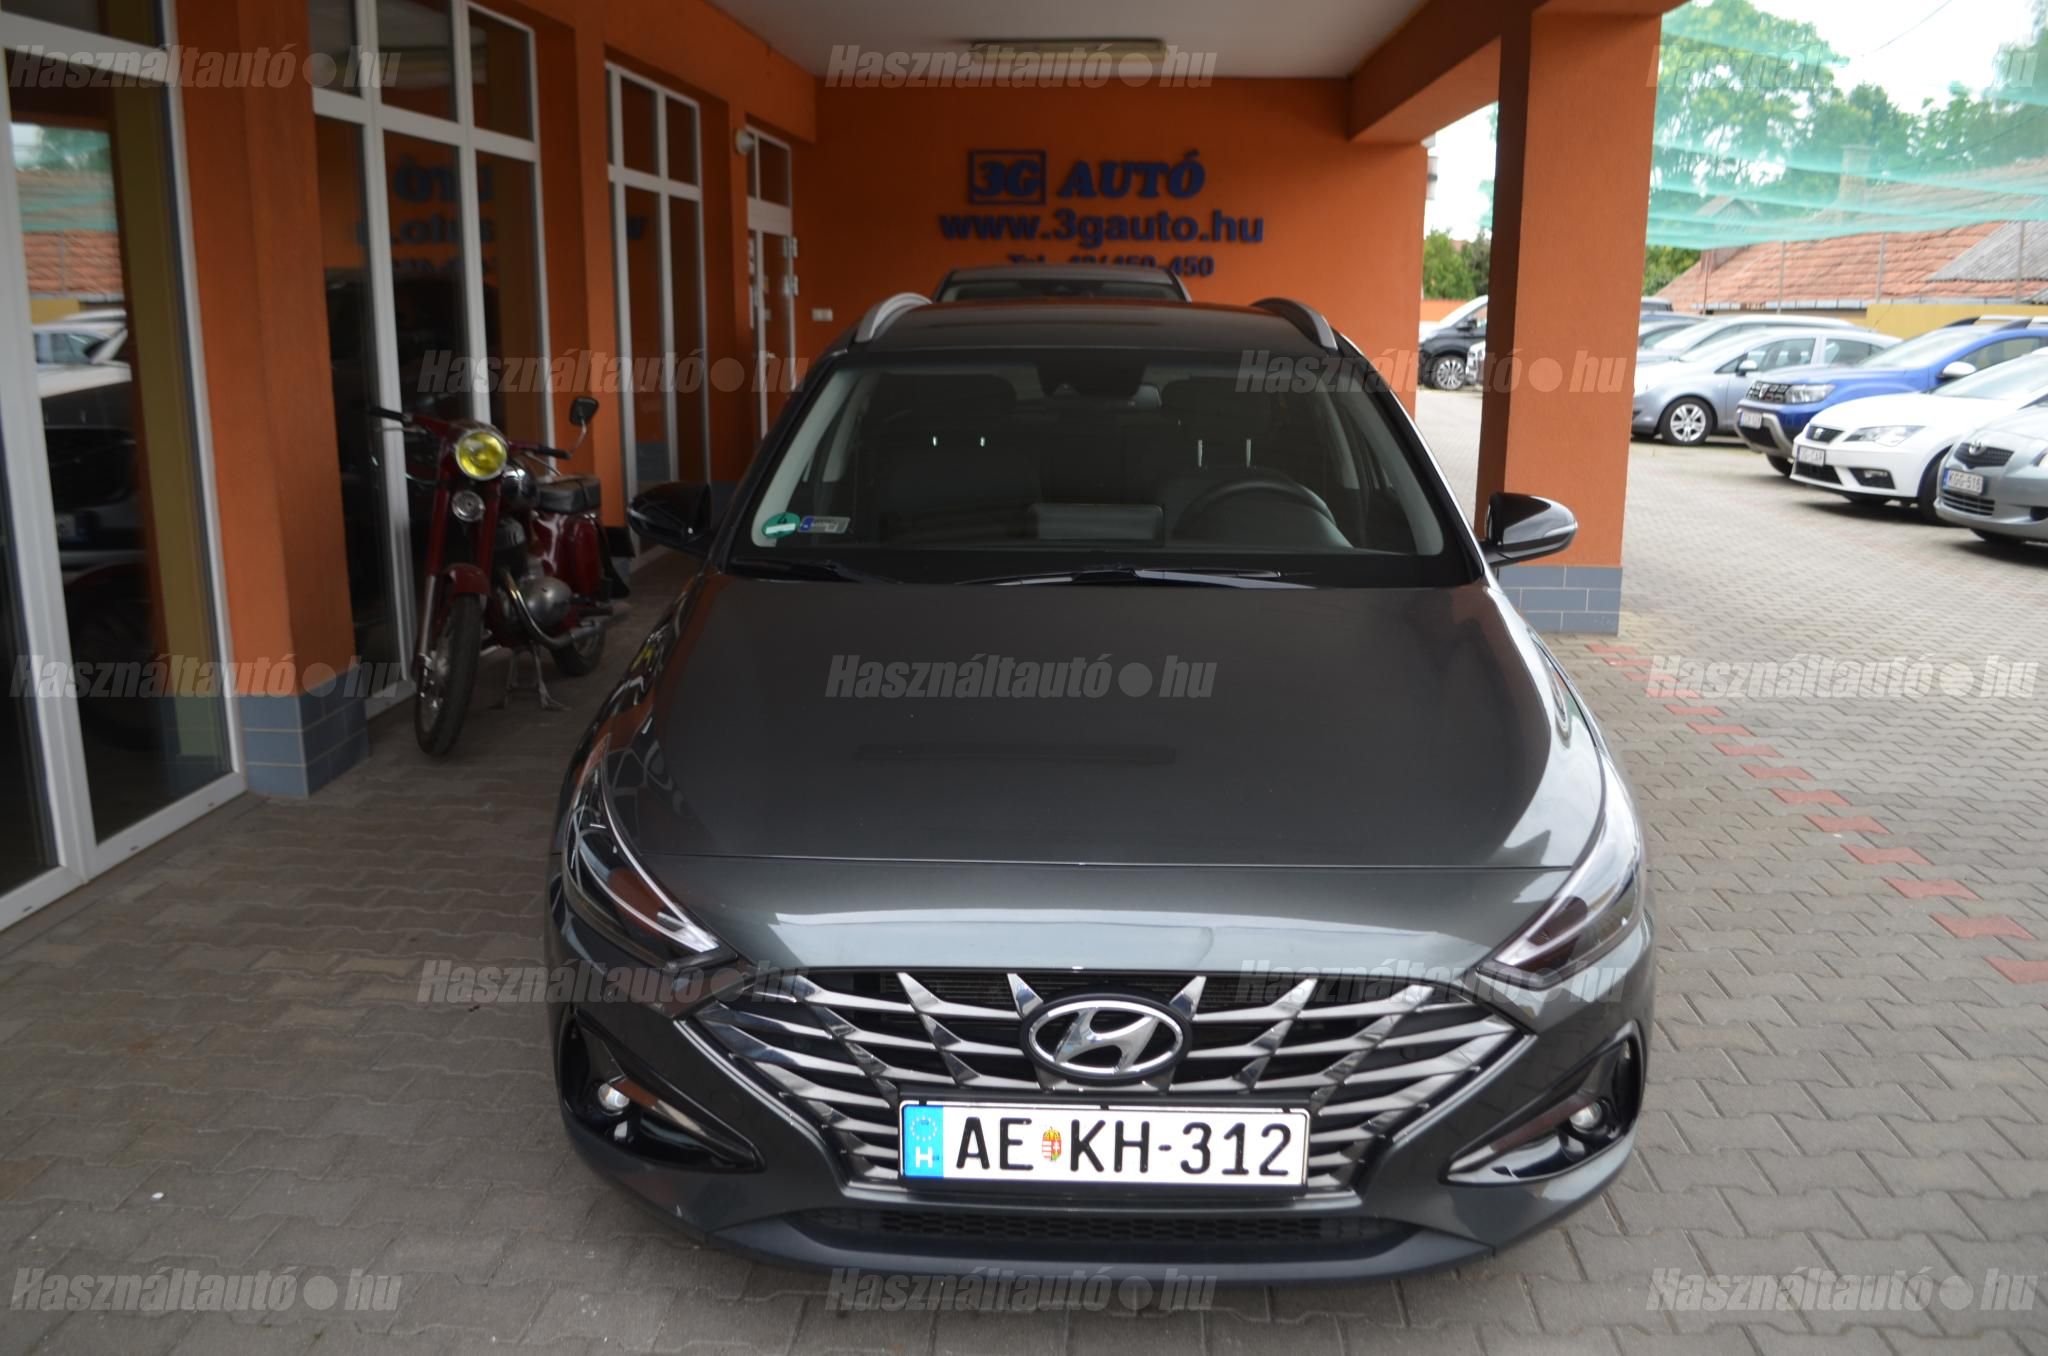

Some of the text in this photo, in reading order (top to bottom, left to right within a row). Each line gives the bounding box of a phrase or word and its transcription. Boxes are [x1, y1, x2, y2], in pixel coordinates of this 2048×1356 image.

[979, 150, 1206, 198] 3G AUTÓ
[938, 208, 1264, 249] www.3gauto.hu
[915, 1116, 1292, 1176] H AE KH-312
